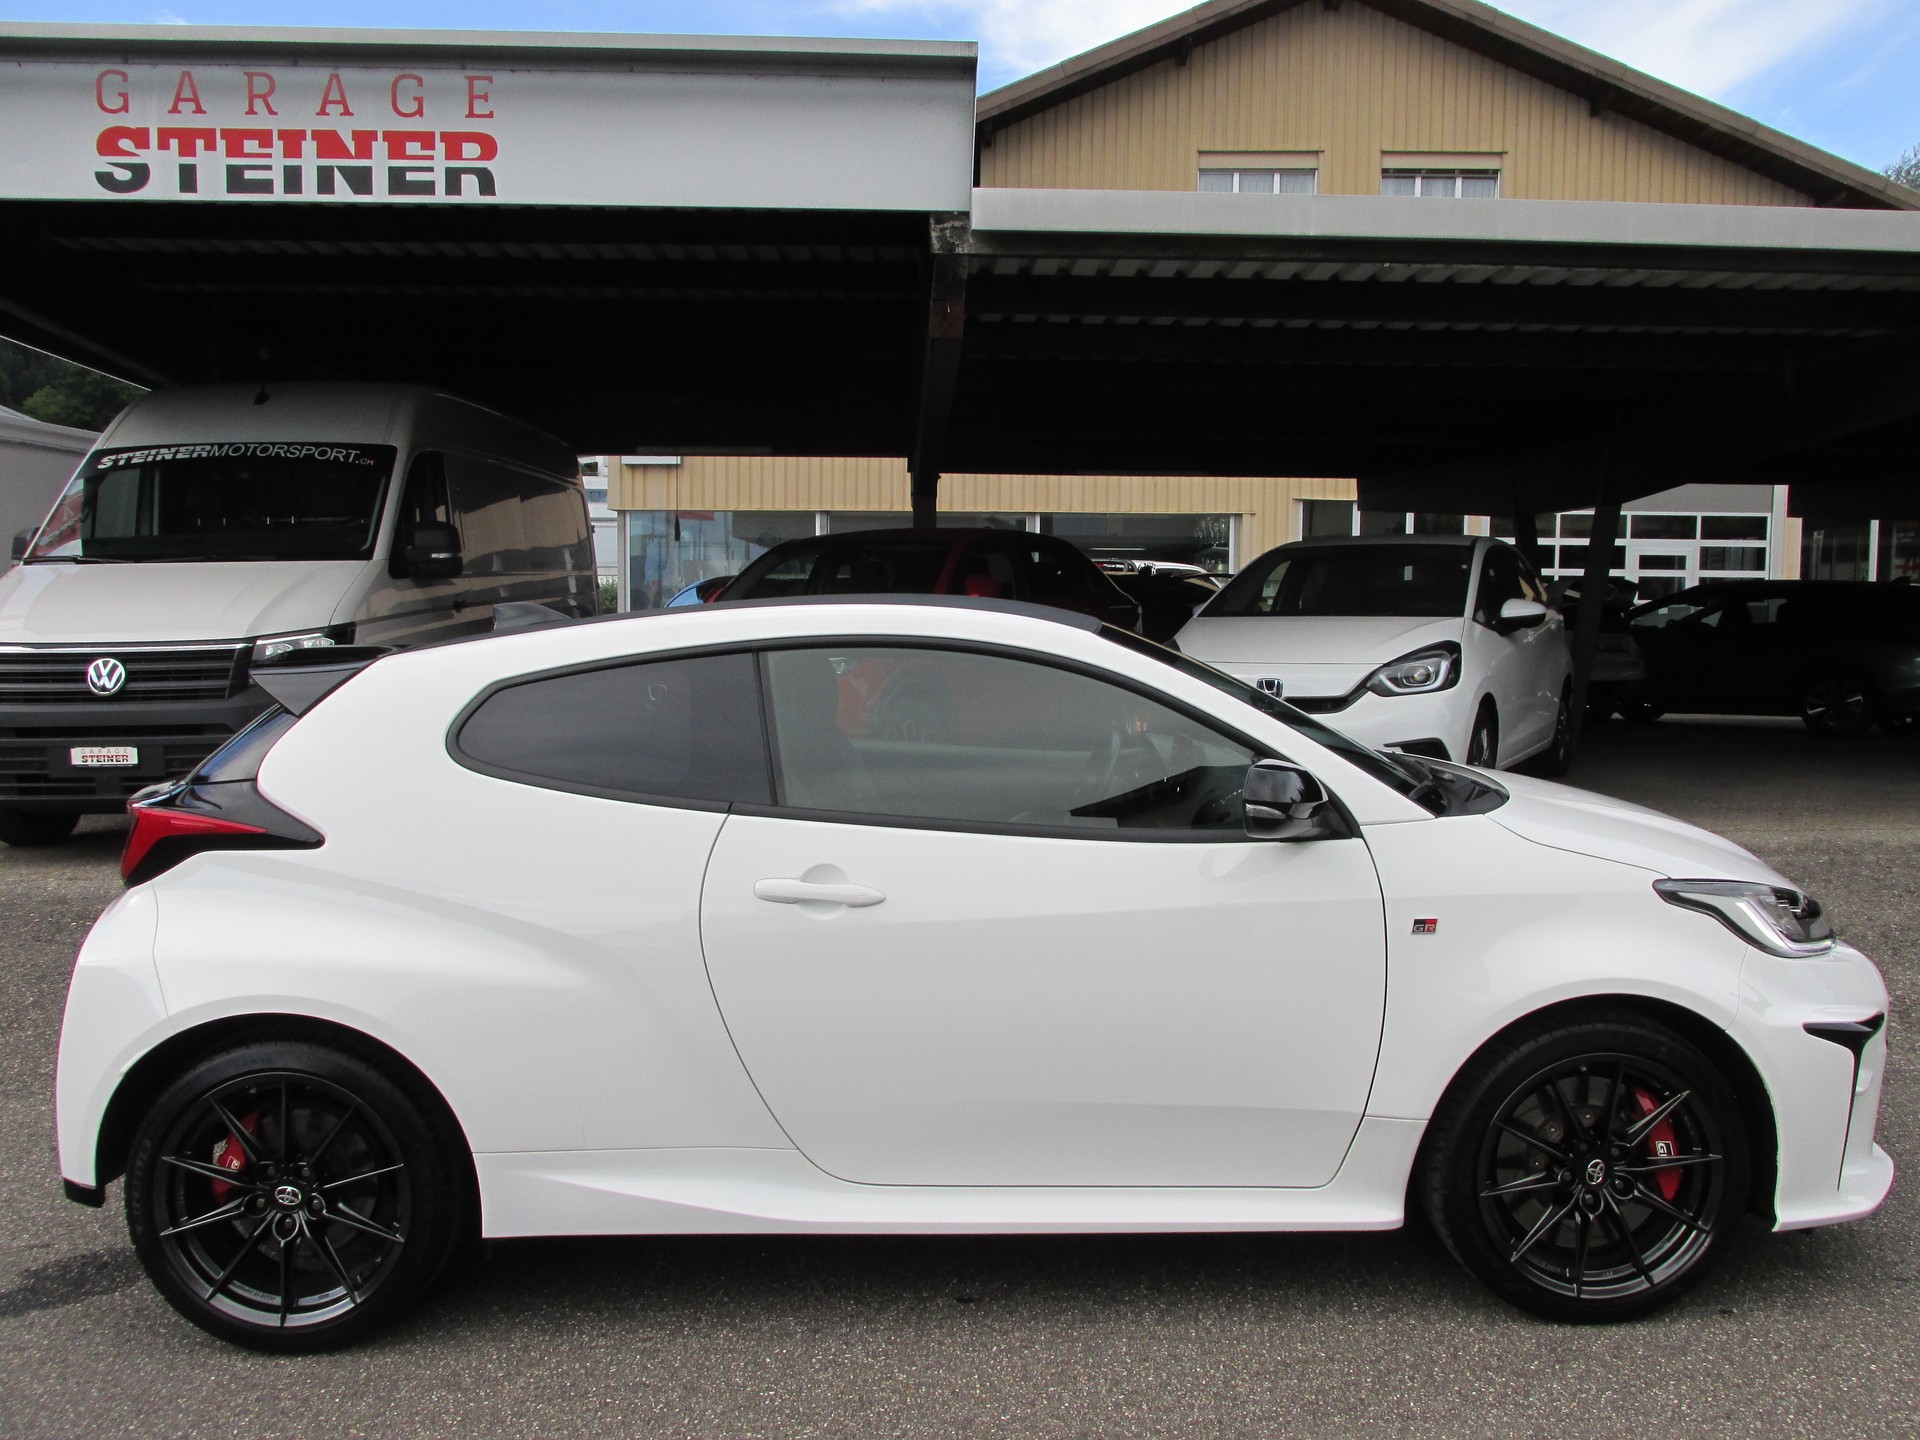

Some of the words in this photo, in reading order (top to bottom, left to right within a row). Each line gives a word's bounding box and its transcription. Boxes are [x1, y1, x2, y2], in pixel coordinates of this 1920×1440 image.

[95, 69, 494, 118] GARAGE
[94, 126, 498, 196] STEINER
[81, 754, 128, 762] STEINER
[1413, 922, 1436, 933] GR
